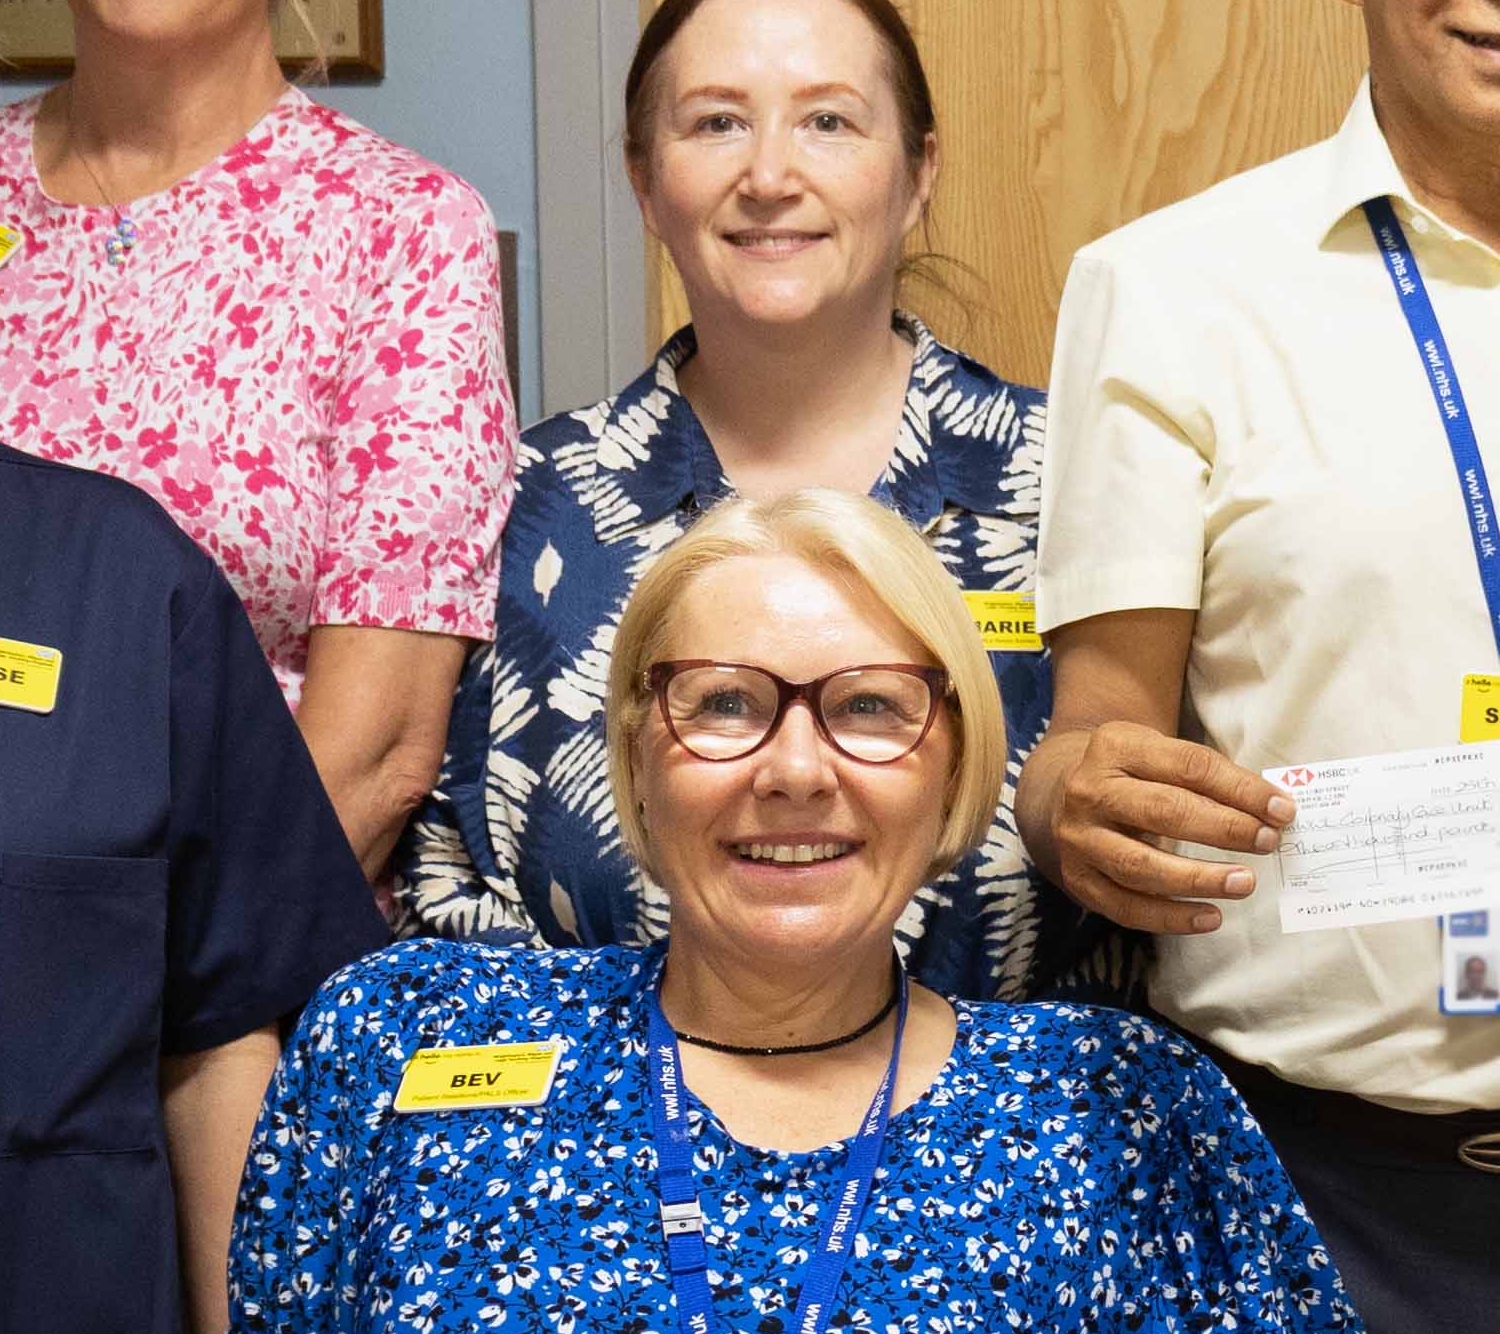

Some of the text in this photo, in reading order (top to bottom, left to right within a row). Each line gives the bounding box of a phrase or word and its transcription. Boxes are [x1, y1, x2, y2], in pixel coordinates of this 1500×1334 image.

[1424, 339, 1460, 419] wwl.nhs.uk
[1465, 469, 1496, 557] wwl.nhs.uk
[1318, 768, 1346, 780] HSBC
[450, 1071, 502, 1088] BEV
[658, 1045, 680, 1120] wwl.nhs.uk
[826, 1178, 860, 1253] wwl.nhs.uk
